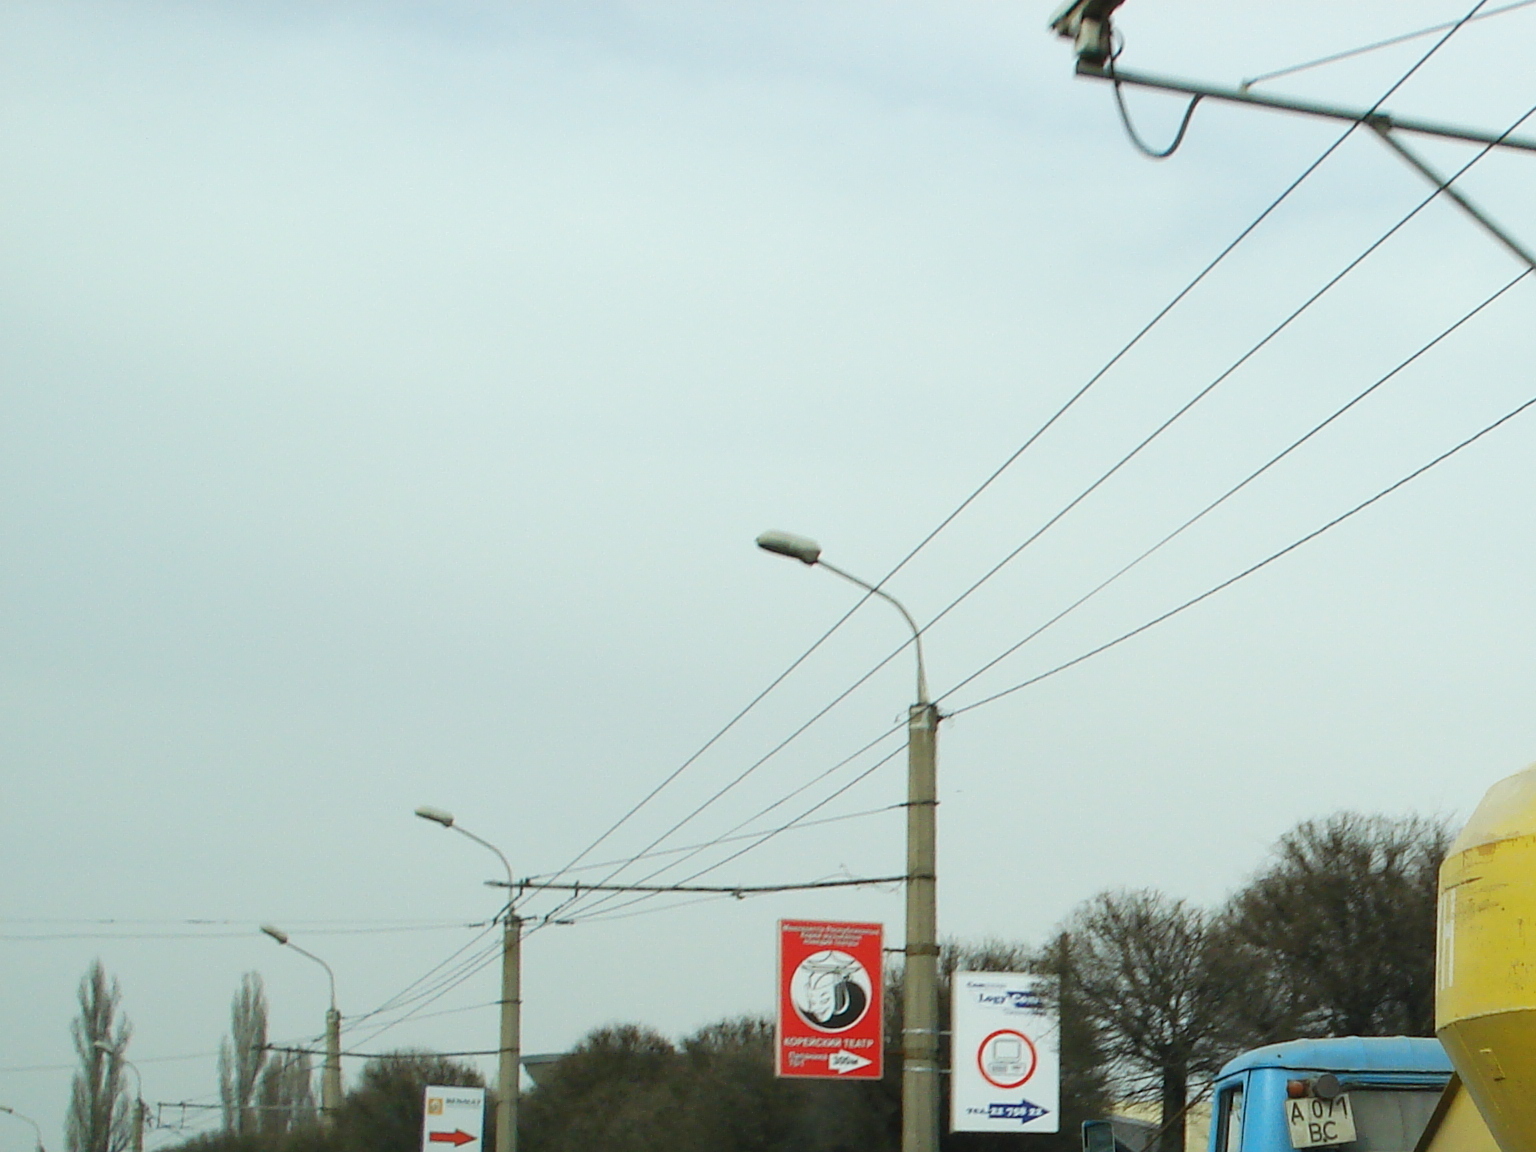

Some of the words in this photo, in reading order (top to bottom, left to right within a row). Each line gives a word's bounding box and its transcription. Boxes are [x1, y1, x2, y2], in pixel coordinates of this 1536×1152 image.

[783, 1036, 842, 1048] КОРЕЙСКИЙ
[843, 1038, 875, 1049] ТЕАТР
[1308, 1120, 1339, 1143] BC
